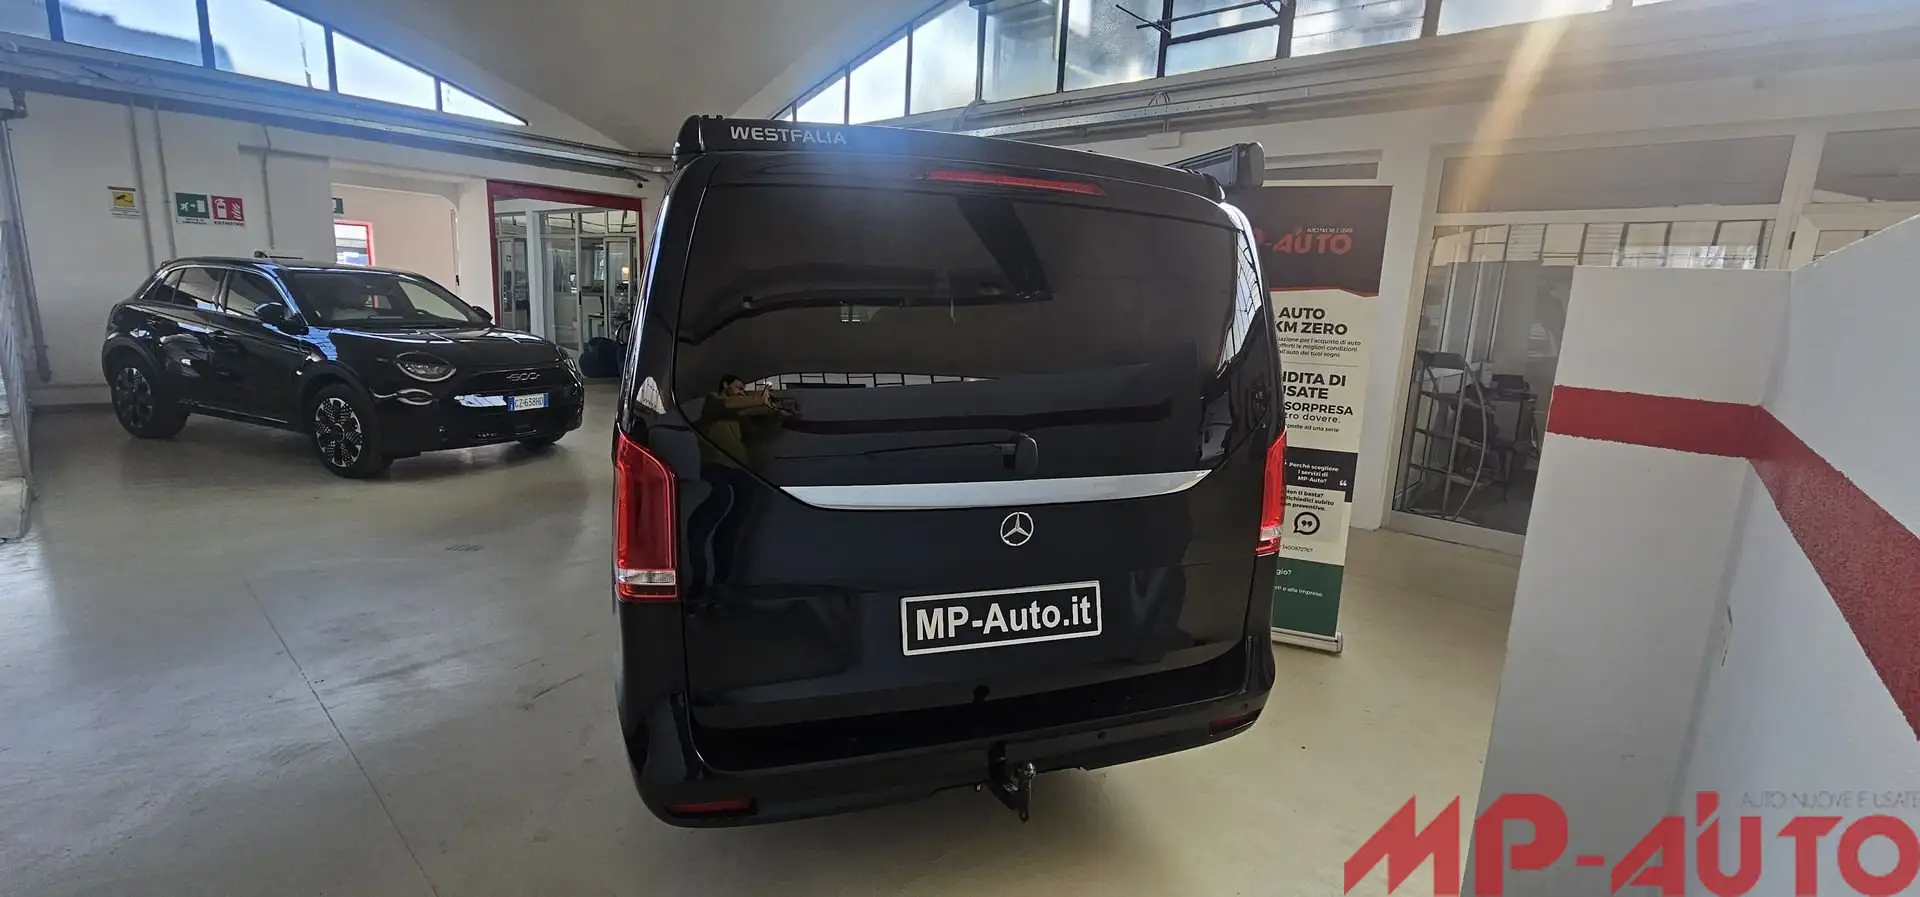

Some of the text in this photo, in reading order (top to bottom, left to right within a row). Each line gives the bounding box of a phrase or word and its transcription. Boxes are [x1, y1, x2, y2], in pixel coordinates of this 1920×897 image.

[730, 126, 847, 144] WESTFALIA
[1278, 306, 1325, 319] AUTO
[1301, 322, 1348, 335] ZERO
[1329, 374, 1346, 386] DI
[1285, 401, 1353, 415] SORPRESA
[1302, 413, 1340, 424] dovere.
[1311, 464, 1339, 472] scegliere
[1298, 476, 1327, 484] MP-Auto?
[916, 596, 1092, 641] MP-Auto.it
